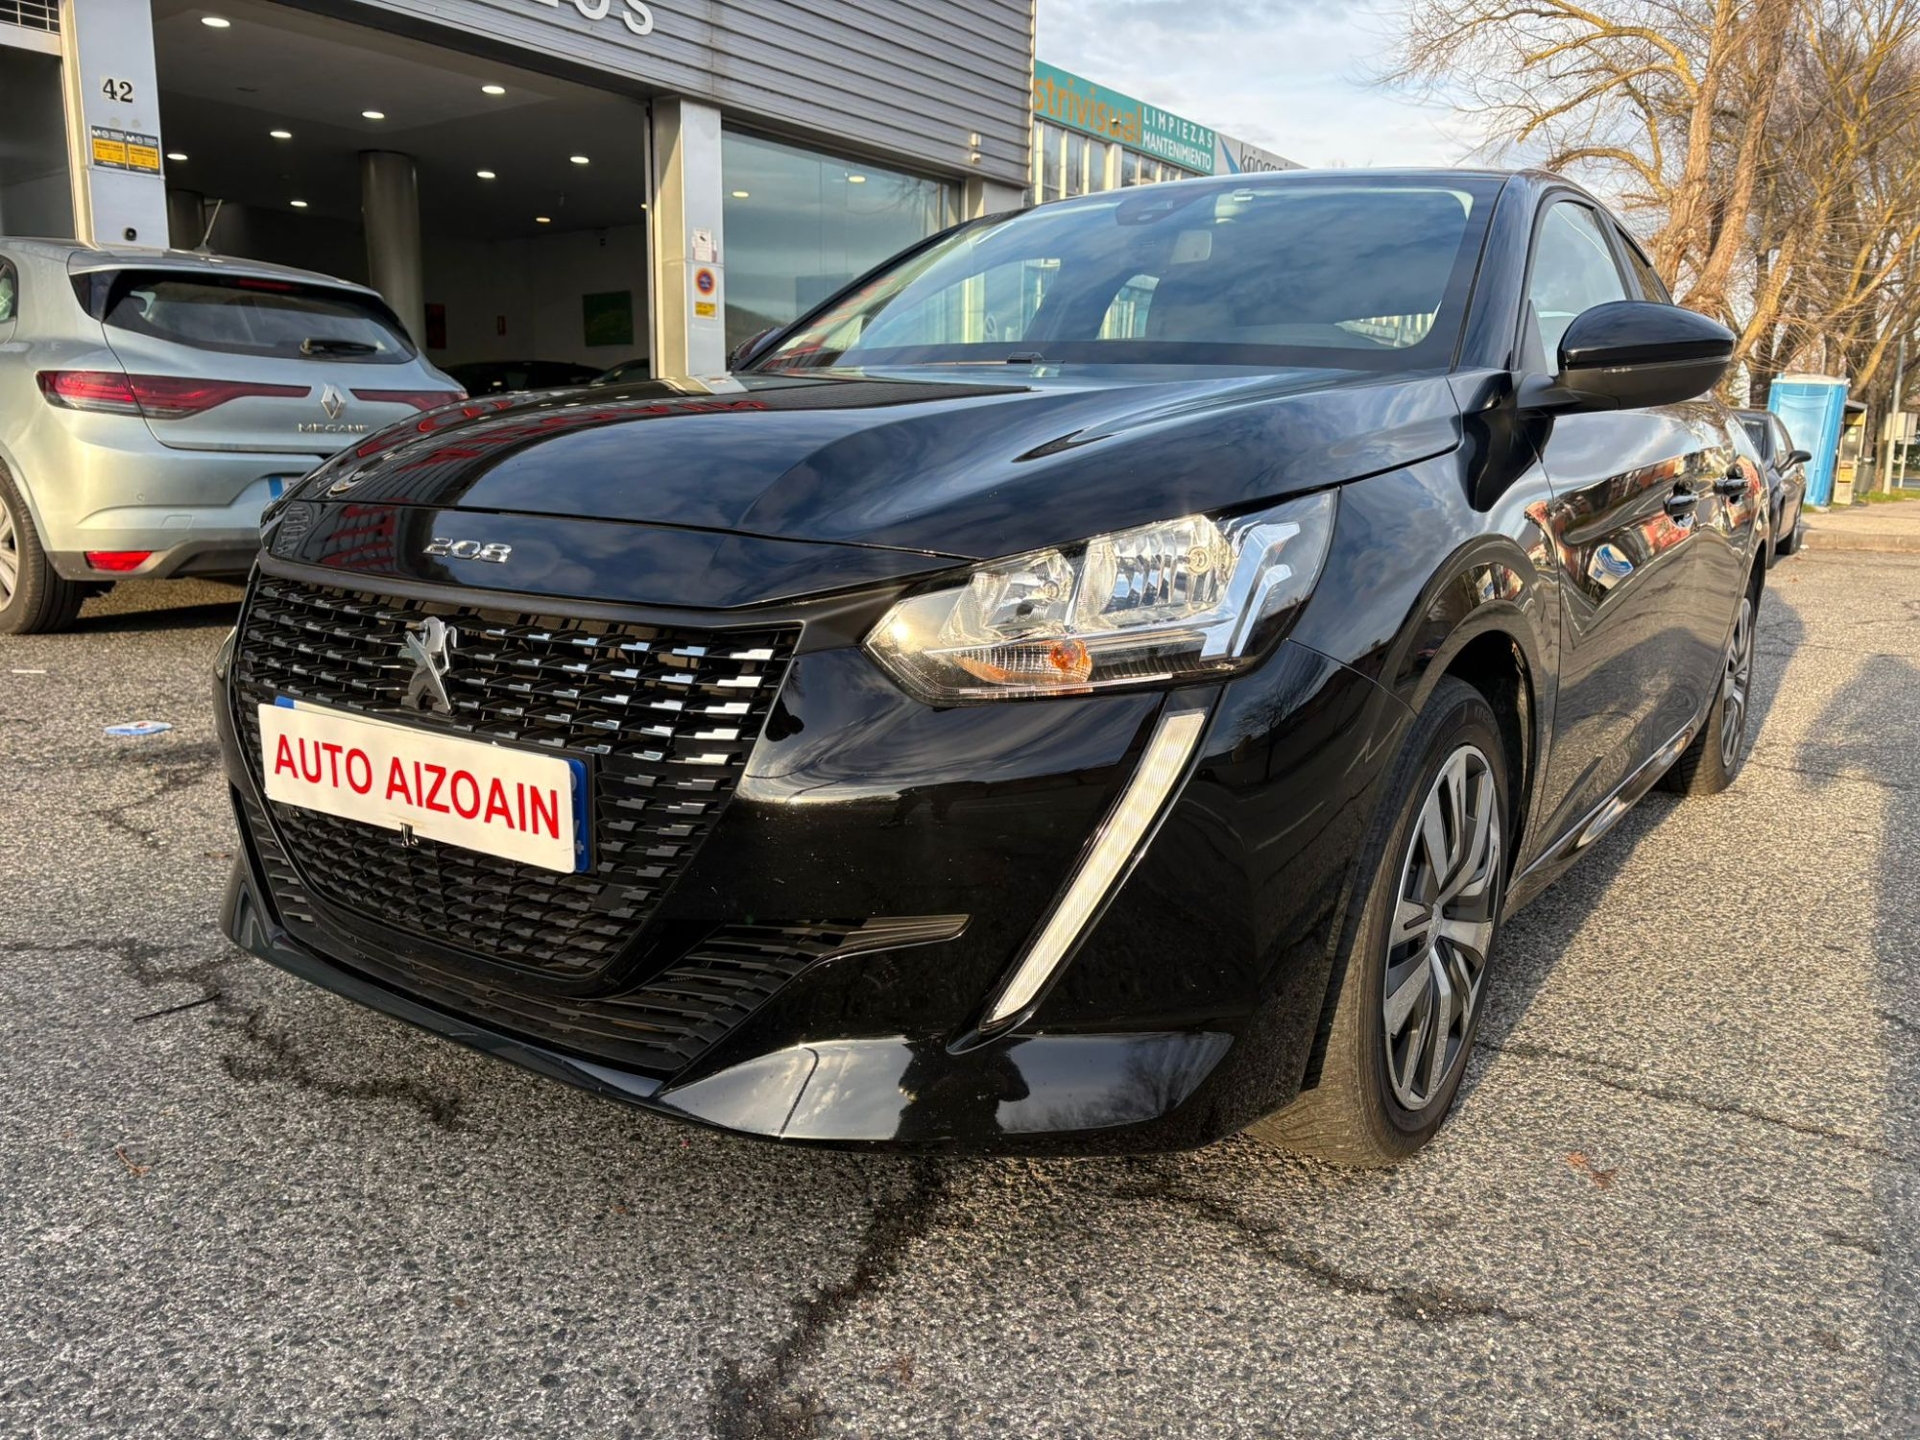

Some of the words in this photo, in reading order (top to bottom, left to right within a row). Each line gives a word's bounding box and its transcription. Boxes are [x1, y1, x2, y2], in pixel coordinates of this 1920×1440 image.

[102, 78, 133, 103] 42
[1034, 76, 1142, 145] strivisual
[1143, 106, 1213, 149] LIMPIEZAS
[1142, 130, 1212, 171] MANTENIMIENTO
[298, 423, 369, 434] MEGANE
[422, 537, 512, 563] 208
[274, 733, 373, 795] AUTO
[385, 756, 560, 840] AIZOAIN
